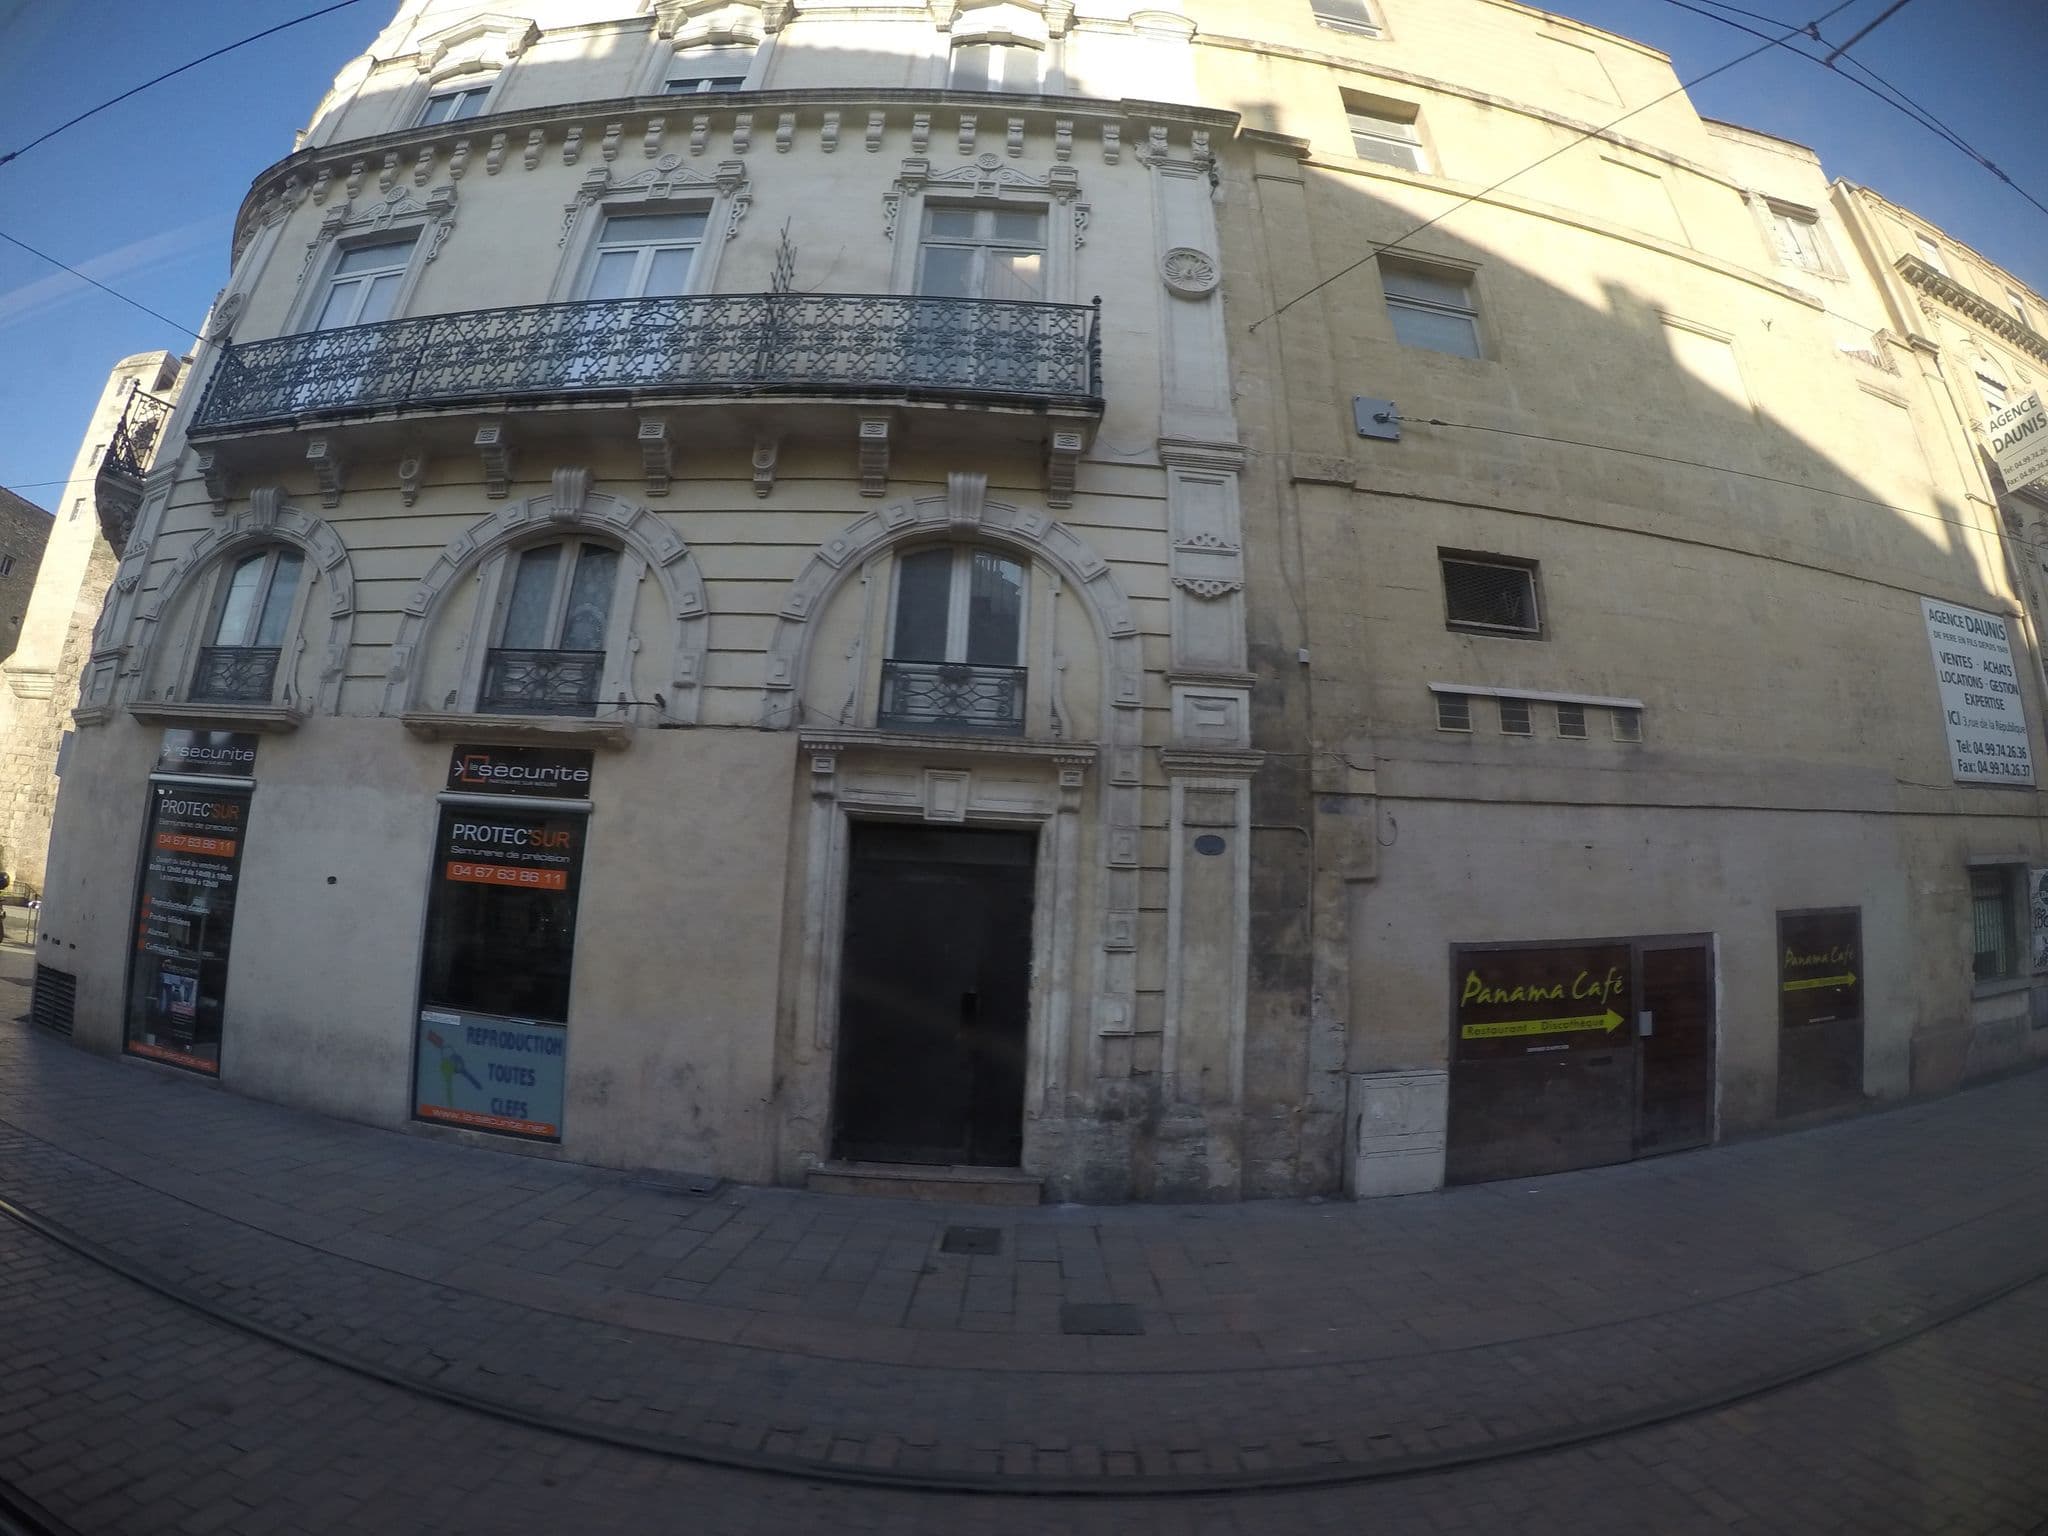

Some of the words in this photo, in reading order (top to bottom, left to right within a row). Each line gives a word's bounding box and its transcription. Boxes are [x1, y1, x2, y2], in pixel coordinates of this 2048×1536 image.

[1990, 395, 2037, 433] AGENCE
[1992, 412, 2047, 454] DAUNIS
[1929, 608, 1965, 629] AGENCE
[1965, 615, 2006, 641] DAUNIS
[1939, 651, 1973, 669] VENTES
[1984, 660, 2013, 677] ACHATS
[1940, 670, 1984, 689] LOCATIONS
[1990, 680, 2019, 695] GESTION
[1964, 693, 2005, 711] EXPERTISE
[1948, 710, 1961, 726] ICI
[1980, 717, 1989, 730] de
[1956, 739, 1972, 754] Tel:
[1973, 741, 2027, 760] 04.99.74.26.36
[1957, 758, 1976, 773] Fax:
[1977, 760, 2030, 777] 04.99.74.26.37
[160, 799, 240, 820] PROTEC'SUR
[452, 823, 570, 848] PROTEC'SUR
[506, 850, 519, 859] de
[474, 867, 494, 878] 67
[544, 873, 561, 885] 11
[1460, 969, 1565, 1008] Panama
[1572, 967, 1624, 1005] Café
[466, 1026, 563, 1056] REPRODUCTION
[1467, 1024, 1527, 1036] Restaurant
[488, 1063, 536, 1087] TOUTES
[491, 1097, 528, 1119] CLEFS
